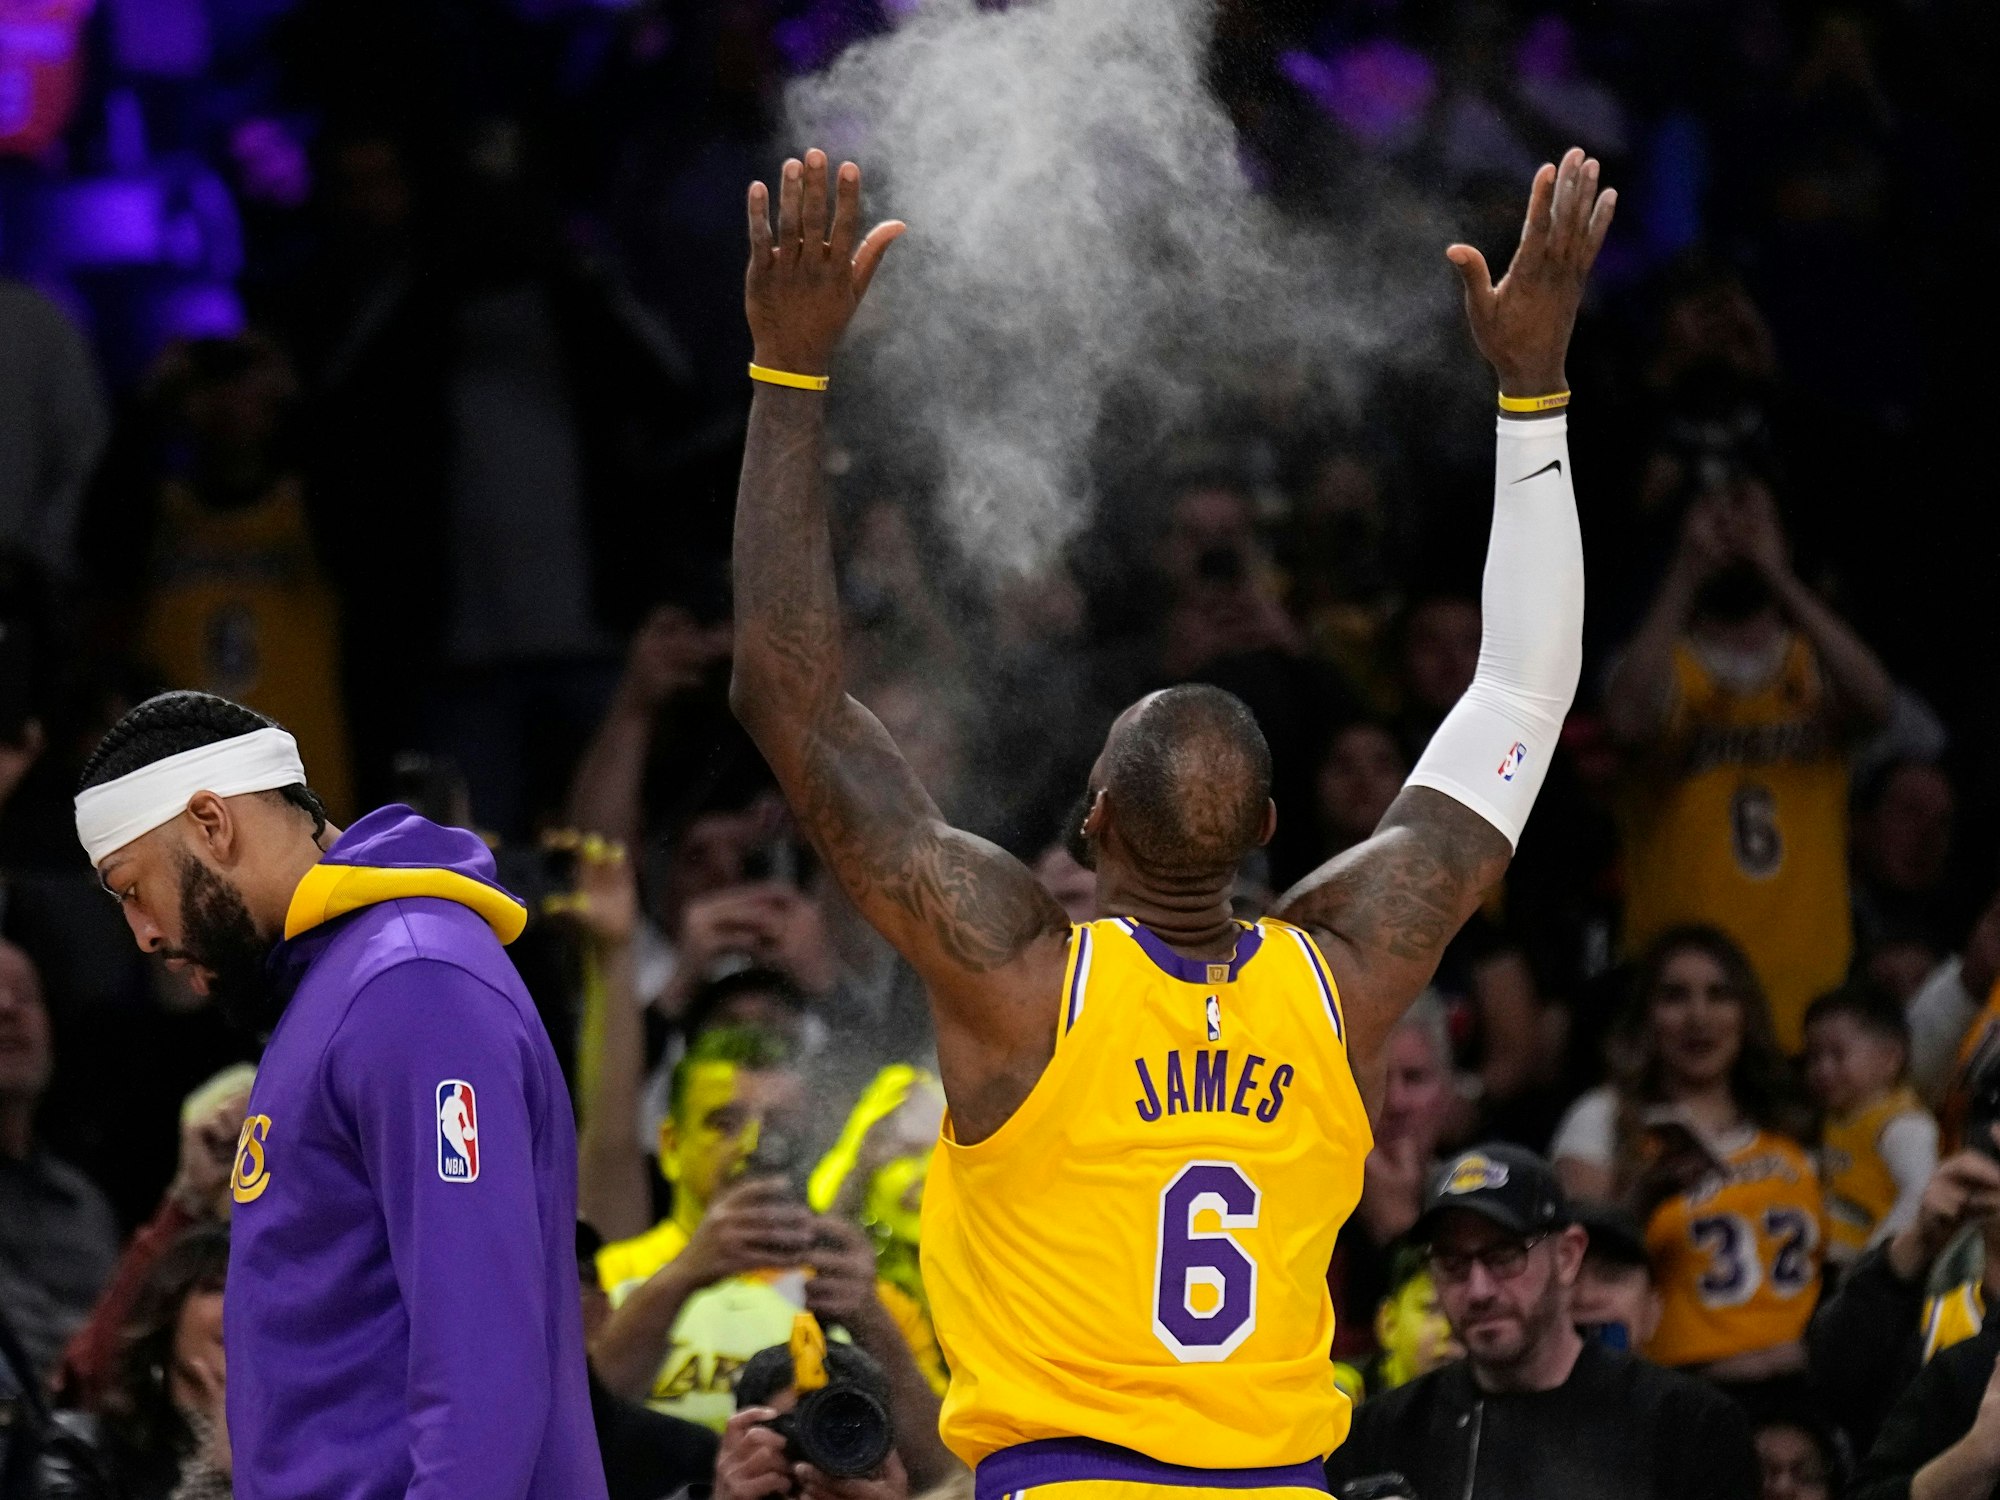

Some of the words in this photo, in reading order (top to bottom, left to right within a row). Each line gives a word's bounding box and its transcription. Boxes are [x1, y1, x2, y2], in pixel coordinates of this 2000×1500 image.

[1730, 784, 1785, 882] 6
[1135, 1050, 1295, 1123] JAMES
[445, 1157, 465, 1176] NBA
[1152, 1159, 1263, 1363] 6
[1692, 1203, 1822, 1311] 32
